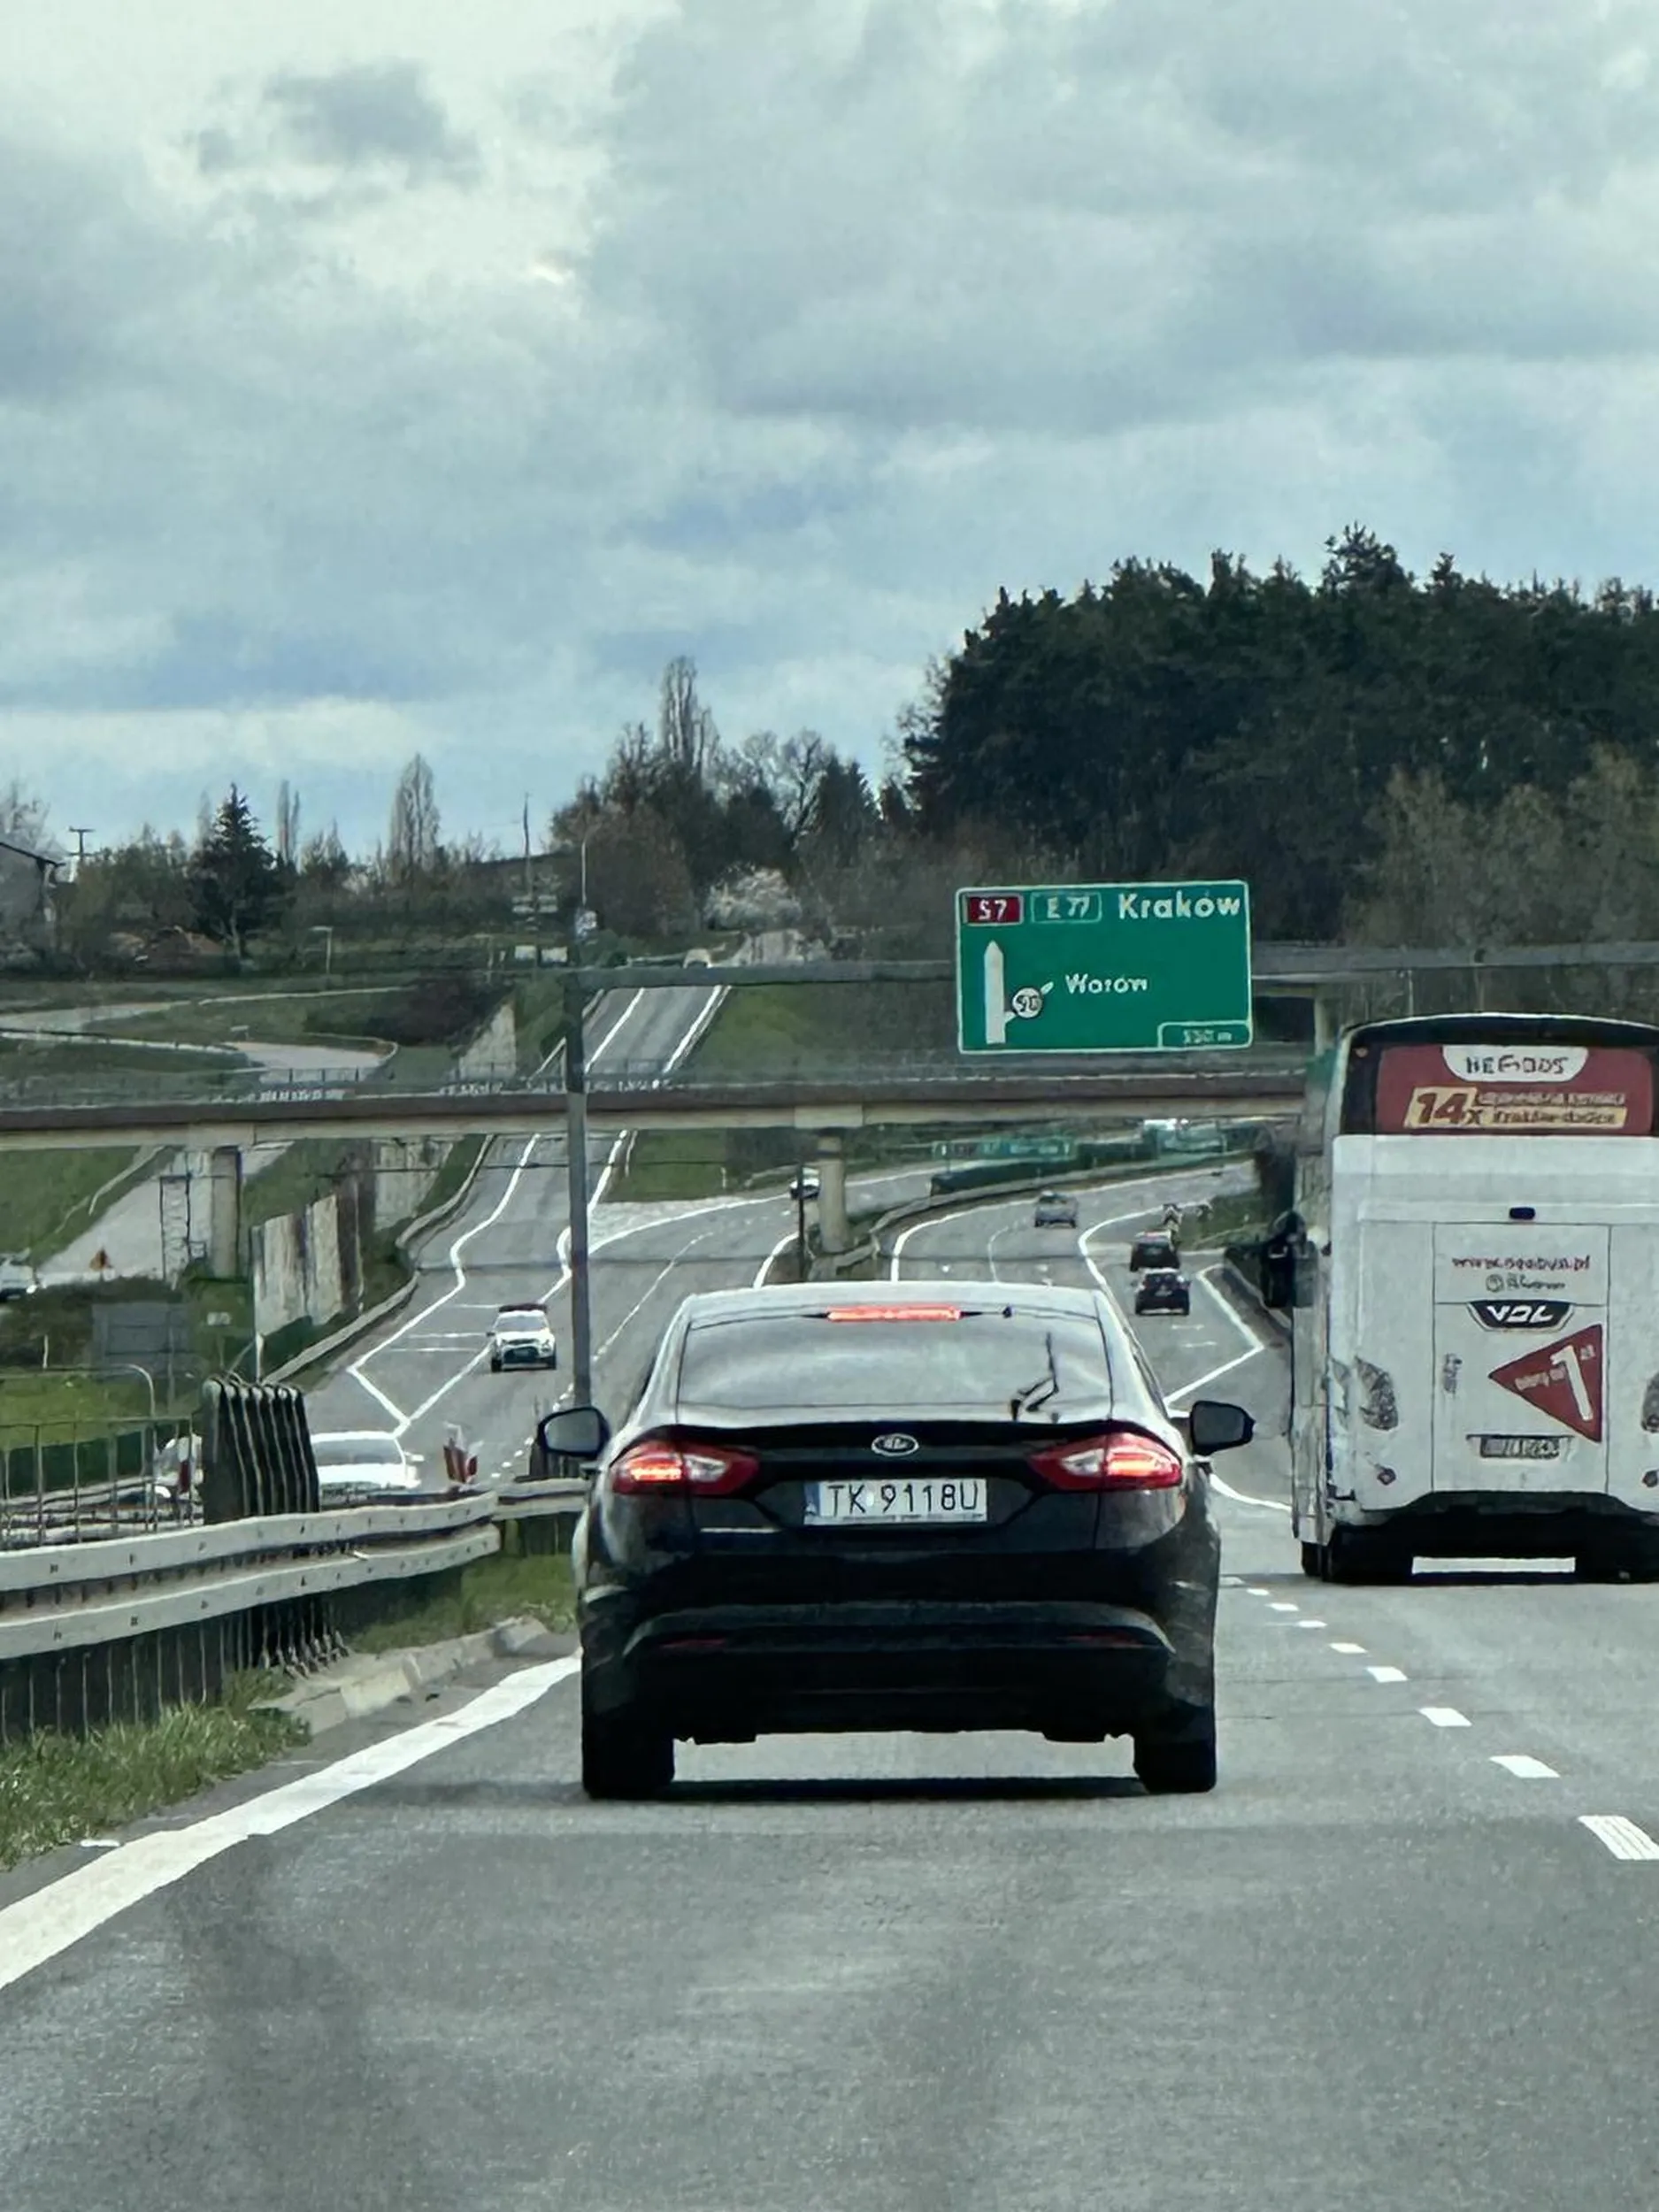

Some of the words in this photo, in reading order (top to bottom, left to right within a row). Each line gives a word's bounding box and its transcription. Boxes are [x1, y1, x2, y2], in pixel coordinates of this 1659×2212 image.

[978, 898, 1008, 921] S7
[1047, 897, 1061, 919] E
[1067, 895, 1091, 918] 77
[1118, 889, 1240, 921] Kraków
[1486, 1305, 1554, 1324] VDL
[827, 1483, 866, 1517] TK
[880, 1481, 979, 1514] 9118U
